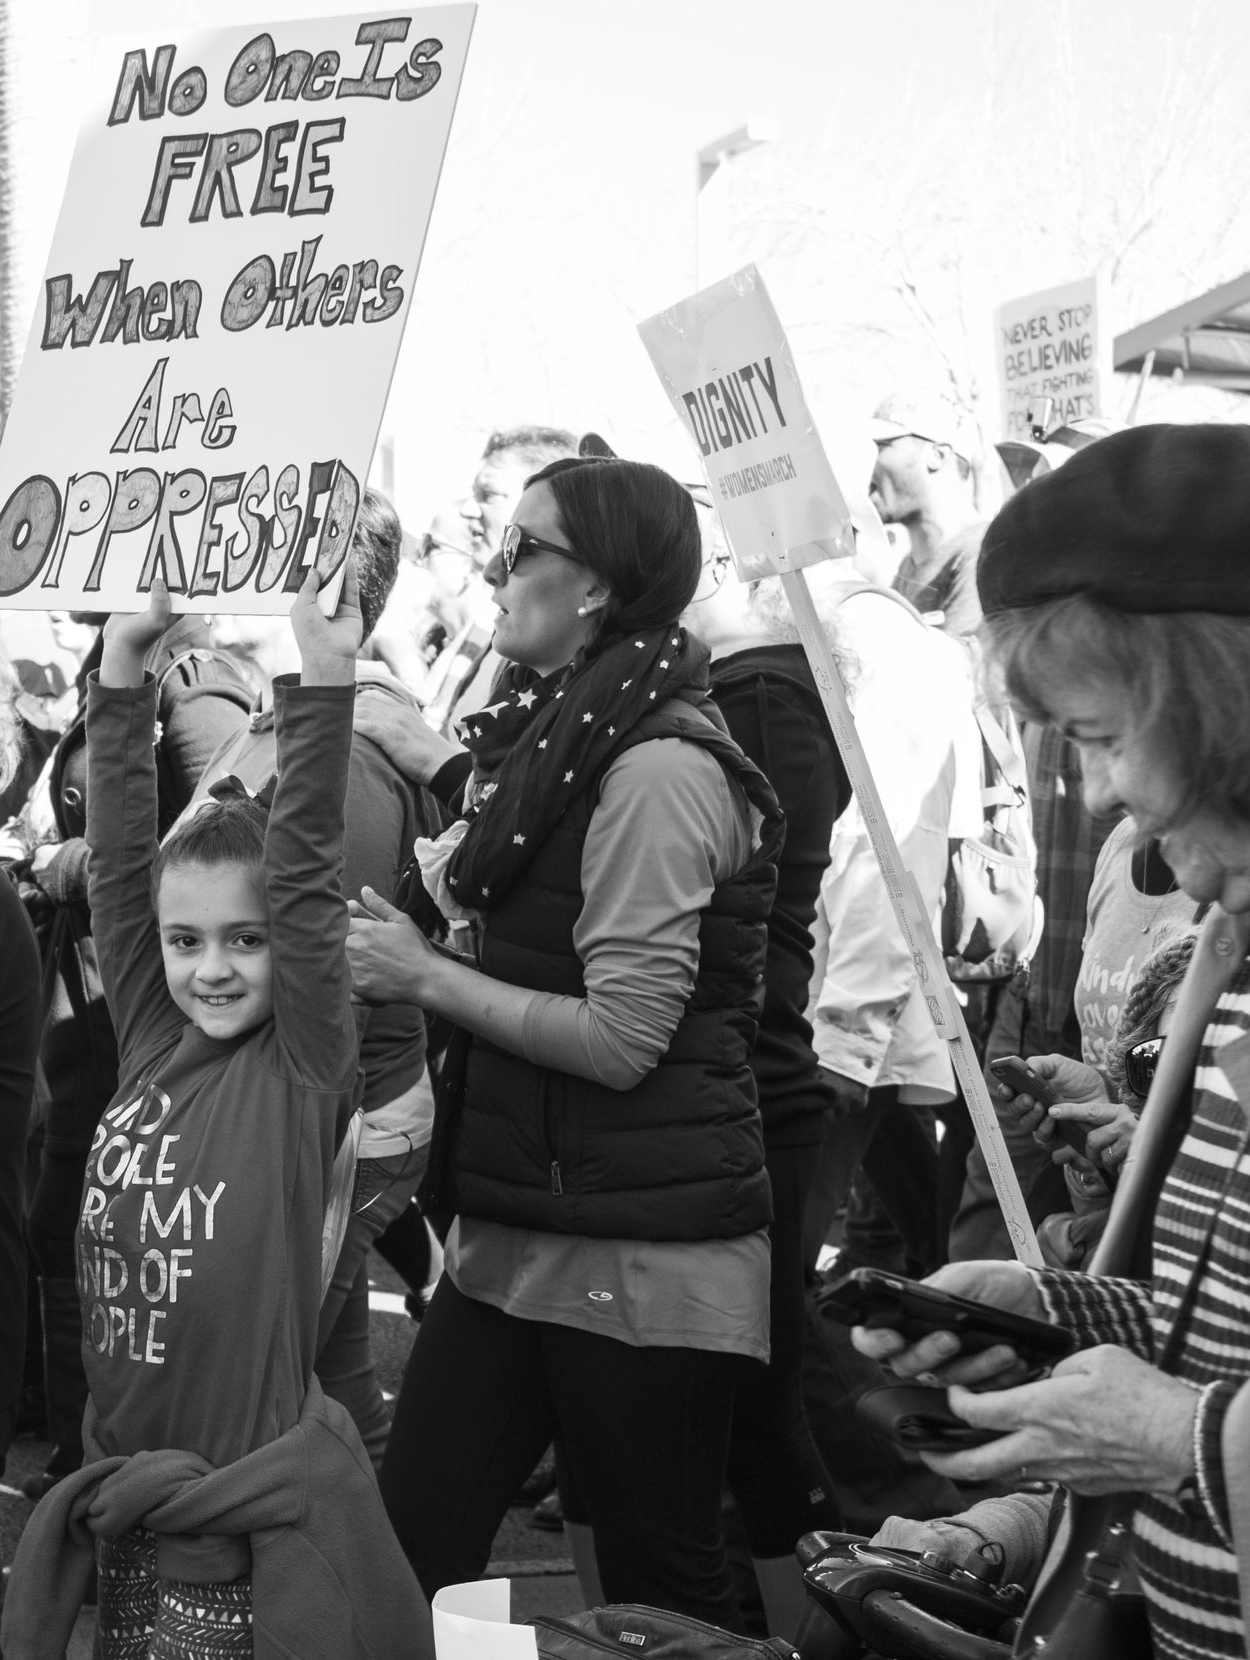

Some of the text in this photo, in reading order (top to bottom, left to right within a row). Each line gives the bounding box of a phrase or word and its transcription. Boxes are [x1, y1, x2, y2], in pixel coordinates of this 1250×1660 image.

[107, 17, 443, 126] No One Is
[140, 117, 346, 228] FREE
[40, 235, 404, 350] When Others
[1001, 304, 1092, 346] NEVER STOP
[1004, 333, 1092, 381] BELIEVING
[1042, 368, 1094, 393] FIGHTING
[110, 357, 236, 454] Are
[682, 356, 787, 457] DIGNITY
[718, 453, 797, 500] #WOMENSMARCH
[81, 1181, 226, 1244] RE MY
[139, 1248, 193, 1303] OF
[83, 1303, 167, 1364] OPLE
